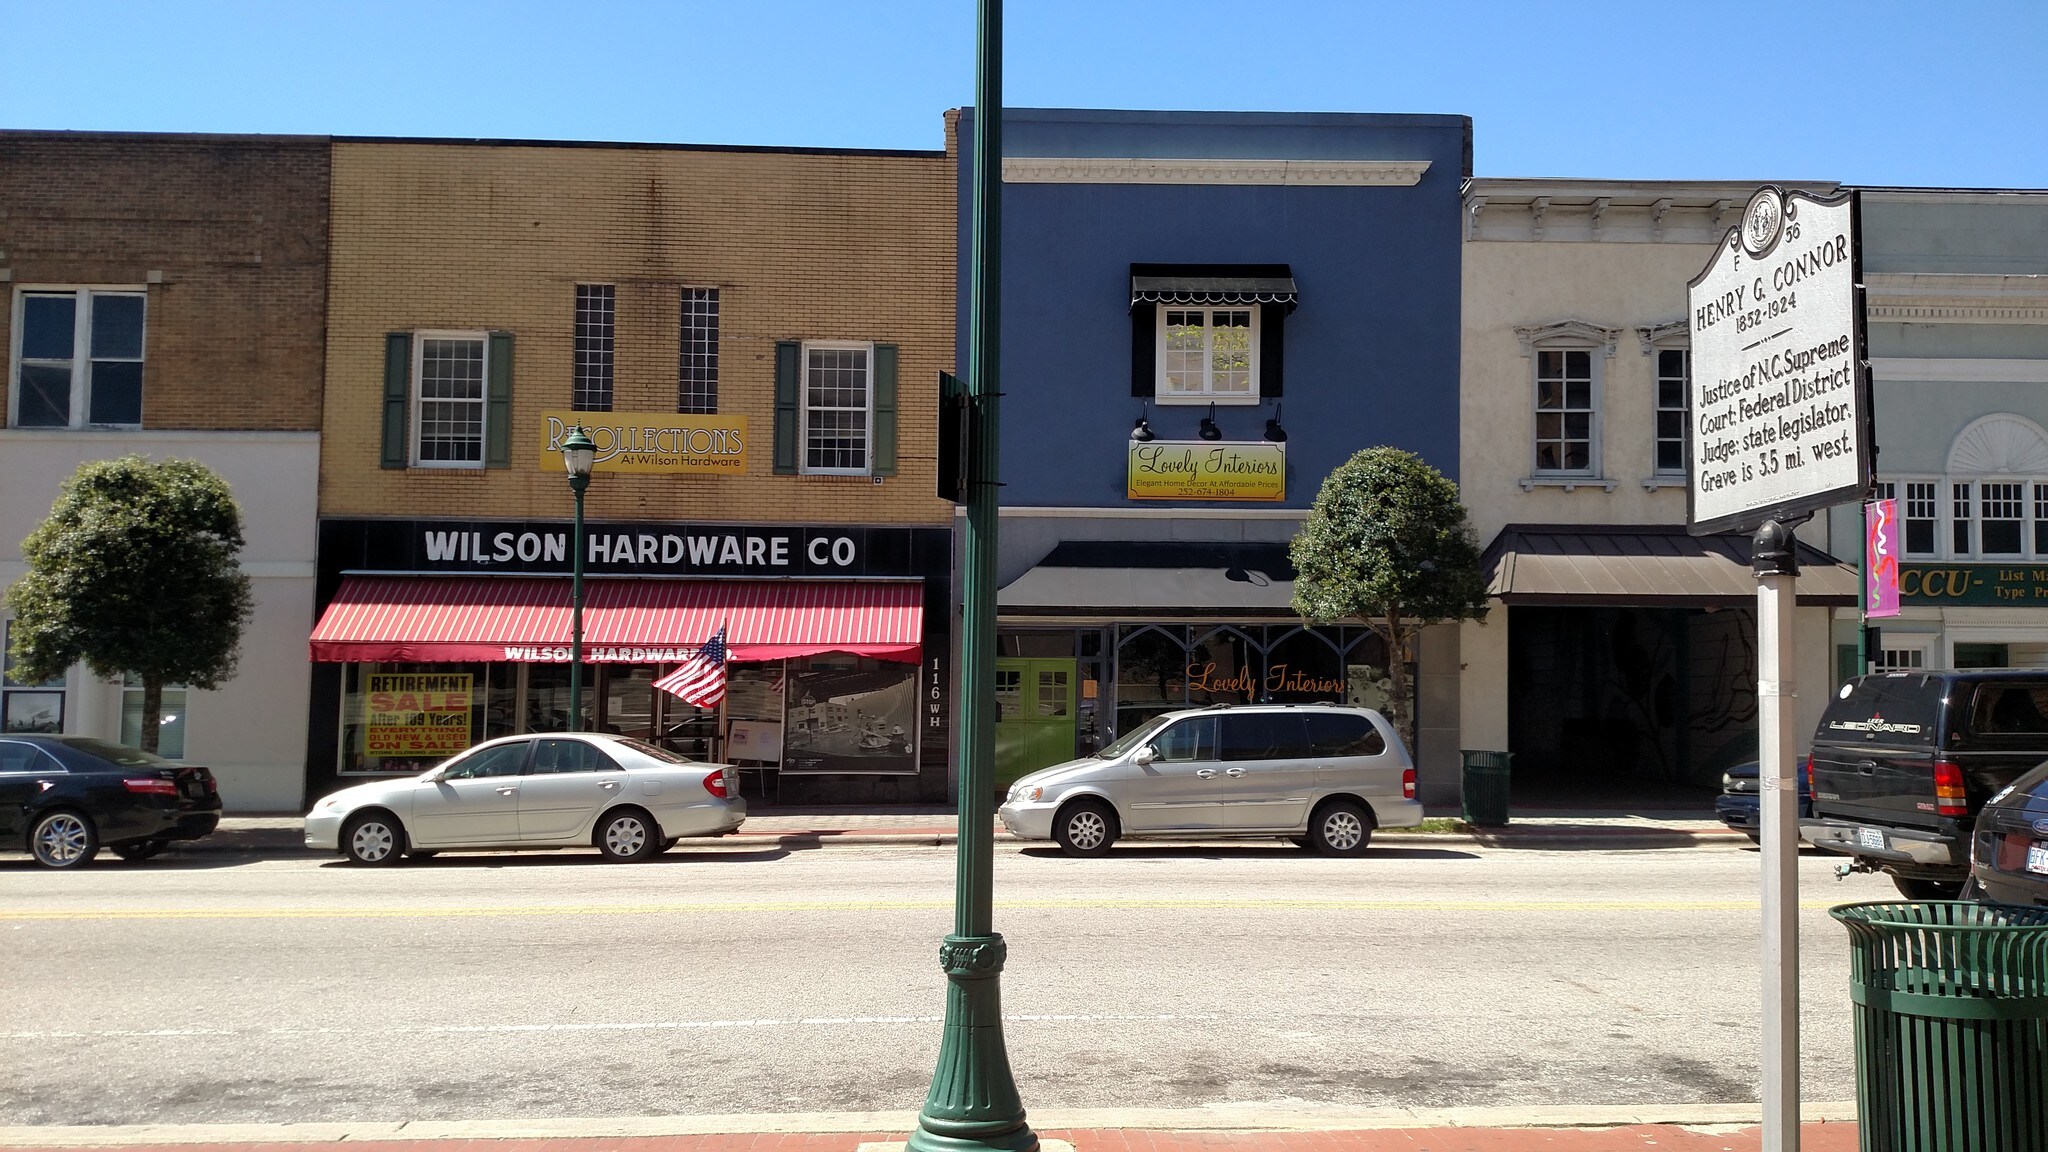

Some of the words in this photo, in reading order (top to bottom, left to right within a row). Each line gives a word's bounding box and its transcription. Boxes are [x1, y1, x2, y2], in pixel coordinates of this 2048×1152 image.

[1733, 254, 1741, 272] F
[1785, 222, 1801, 243] 56
[1696, 284, 1745, 332] HENRY
[1753, 277, 1766, 301] G.
[1773, 234, 1848, 291] CONNOR
[1736, 291, 1797, 334] 1852-1924
[1700, 379, 1741, 408] Justice
[1742, 364, 1757, 390] of
[1784, 334, 1850, 374] Supreme
[1739, 382, 1790, 423] Federal
[1792, 361, 1851, 404] District
[1701, 437, 1740, 465] Judge;
[1742, 422, 1776, 452] state
[1778, 401, 1852, 441] legislator.
[621, 454, 635, 465] At
[637, 454, 678, 466] Wilson
[681, 455, 740, 467] Hardware
[1138, 446, 1198, 481] Lovely
[1204, 447, 1277, 475] Interiors
[1701, 468, 1737, 492] Grave
[1742, 462, 1753, 482] is
[1759, 449, 1779, 477] 3.5
[1785, 446, 1805, 471] mi.
[1812, 429, 1853, 461] west.
[1136, 480, 1162, 488] Elegant
[1219, 480, 1256, 488] Affordable
[1178, 488, 1235, 496] 252-674-1804
[424, 531, 566, 562] WILSON
[588, 534, 789, 566] HARDWARE
[808, 537, 856, 566] CO
[2000, 570, 2025, 582] List
[1994, 586, 2025, 599] Type
[371, 676, 469, 692] RETIREMENT
[1186, 662, 1256, 700] Lovely
[1264, 664, 1345, 693] Interiors
[370, 693, 468, 712] SALE
[370, 713, 400, 726] After
[429, 712, 467, 726] Years!
[1829, 720, 1921, 734] LEONARD
[409, 741, 466, 749] SALE
